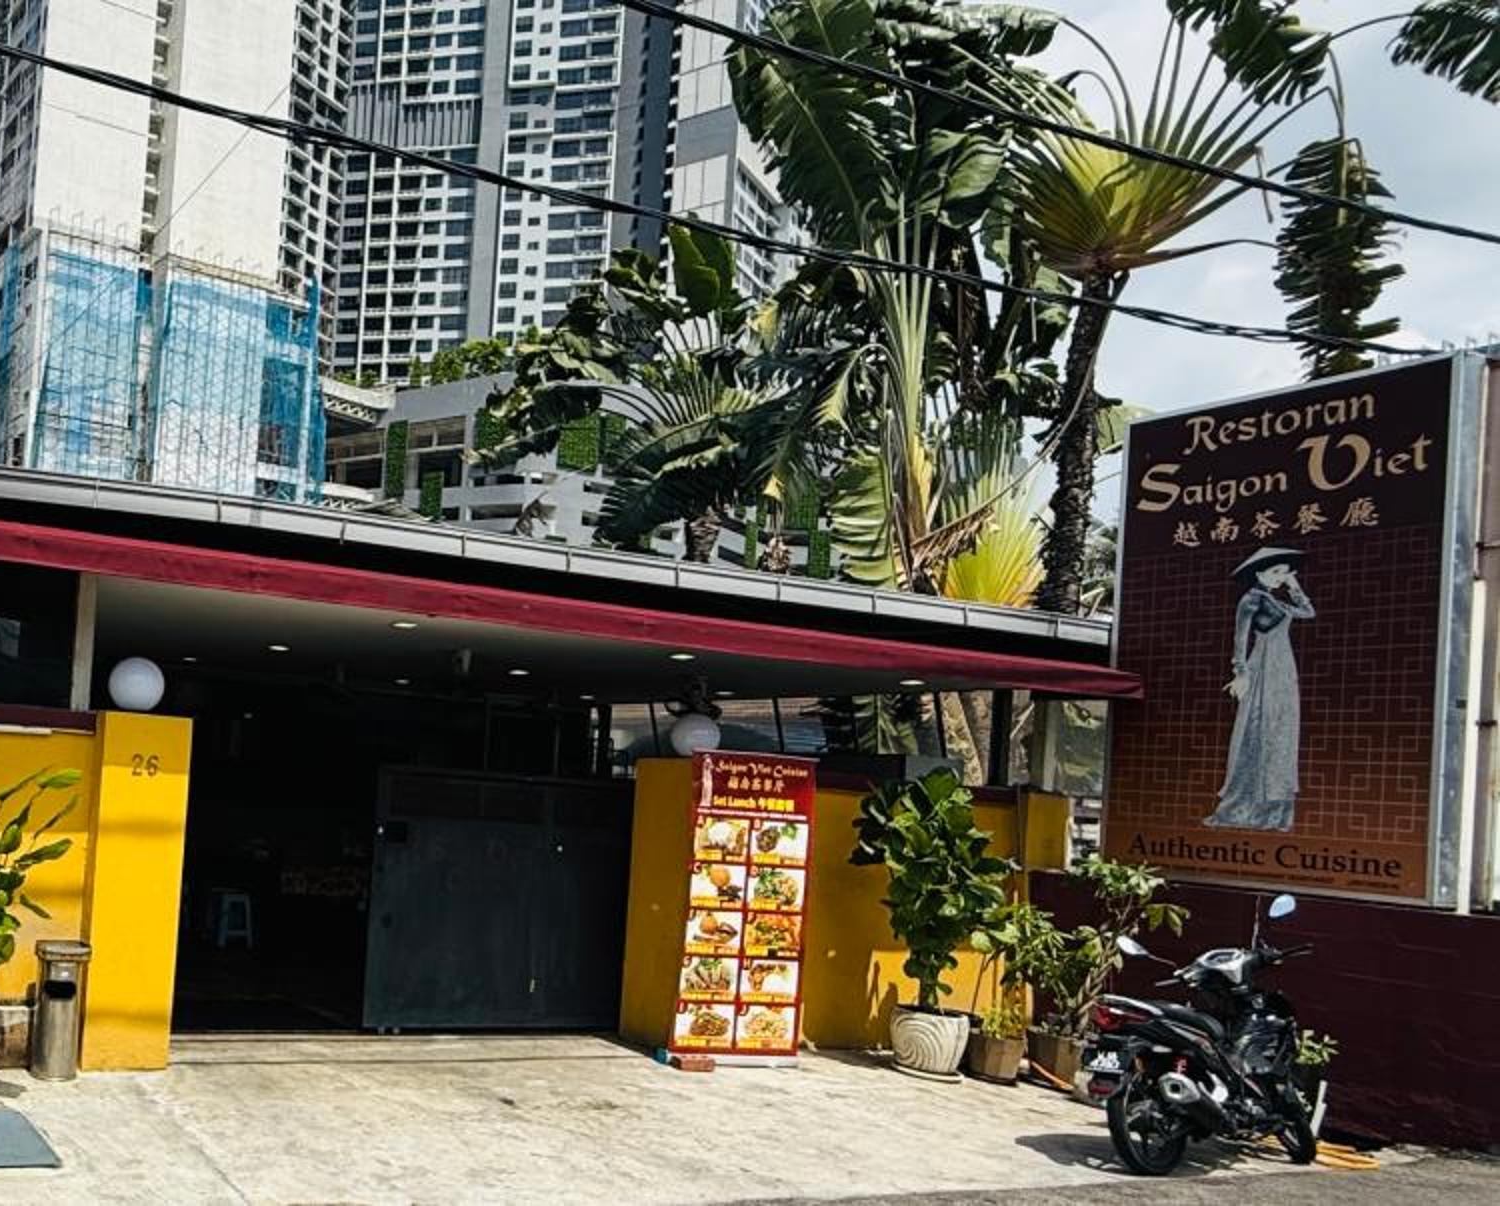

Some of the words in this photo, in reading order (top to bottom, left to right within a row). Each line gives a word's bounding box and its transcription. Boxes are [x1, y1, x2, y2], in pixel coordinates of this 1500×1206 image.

[1183, 393, 1375, 455] Restoran
[1137, 463, 1288, 513] Saigon
[1297, 433, 1432, 491] Viet
[1173, 496, 1380, 547] 越南茶餐廳
[131, 753, 160, 777] 26
[1129, 833, 1265, 866] Authentic
[1275, 844, 1403, 878] Cuisine
